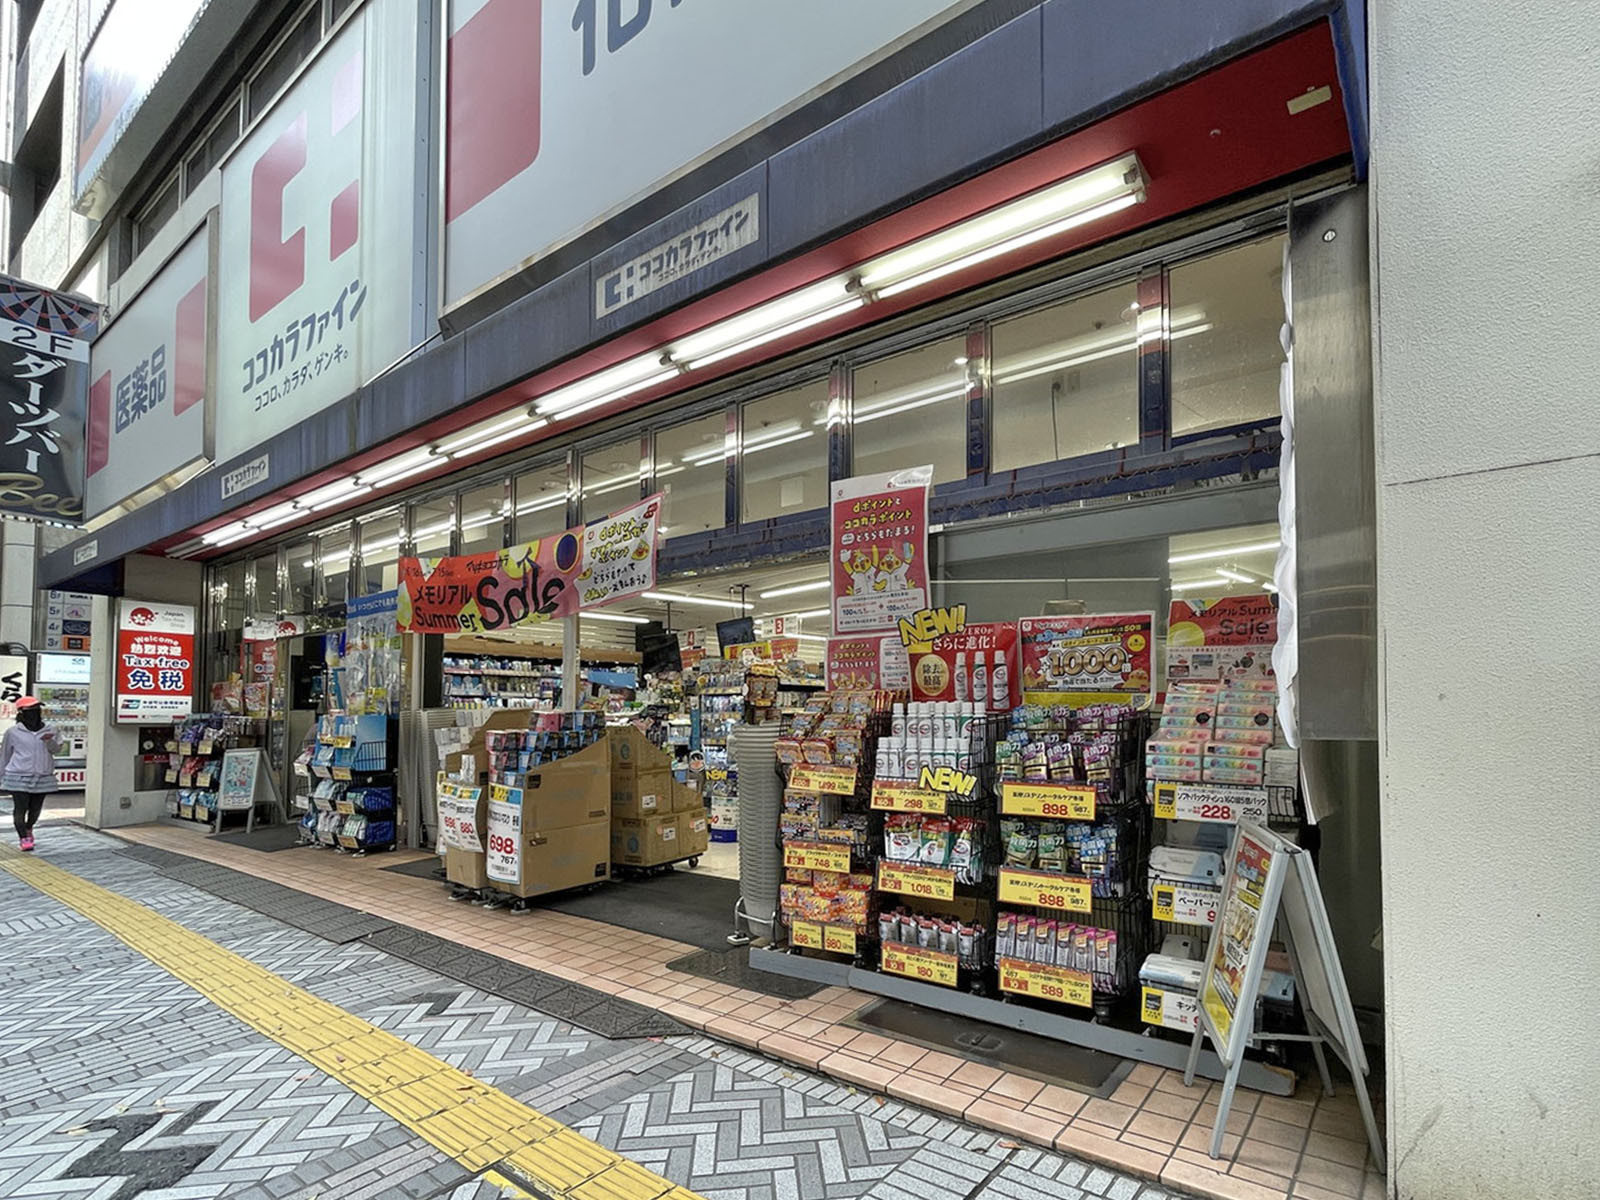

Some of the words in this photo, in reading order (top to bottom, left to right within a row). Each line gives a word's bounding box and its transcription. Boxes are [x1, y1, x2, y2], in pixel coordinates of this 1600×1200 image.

[640, 210, 749, 281] ココカラファイン
[11, 325, 74, 353] 2F
[243, 279, 367, 393] ココカラファイン
[115, 343, 167, 434] 医薬品
[5, 352, 67, 473] ダーツバー
[414, 606, 478, 632] Summer
[475, 551, 565, 631] Sale
[414, 585, 473, 605] メモリアル
[775, 619, 784, 633] 3
[897, 604, 967, 648] NEW!
[1218, 618, 1270, 636] Sale
[134, 635, 180, 646] Welcome
[932, 635, 997, 650] さらに進化!
[129, 669, 183, 690] 免税
[55, 771, 84, 782] IRI
[919, 766, 978, 796] NEW!
[903, 798, 923, 809] 298
[1042, 803, 1068, 815] 898
[1200, 804, 1231, 819] 228
[489, 834, 514, 855] 698
[500, 855, 515, 864] 767
[814, 858, 831, 868] 748
[1038, 893, 1065, 907] 898
[826, 937, 841, 949] 980
[917, 965, 933, 977] 180
[1041, 984, 1064, 998] 589
